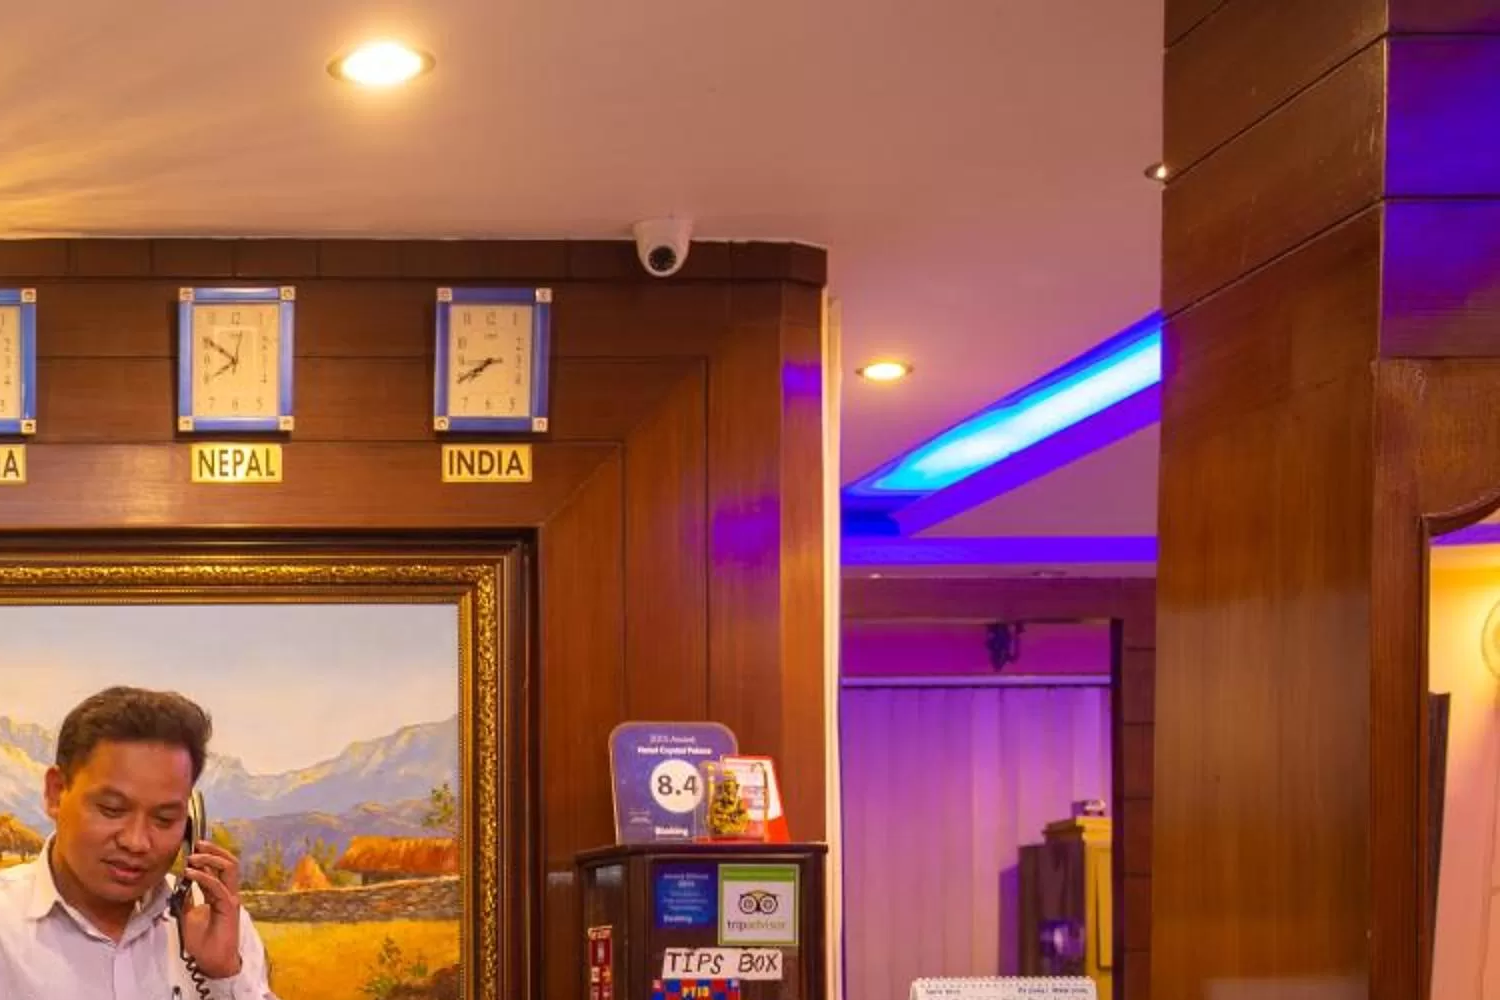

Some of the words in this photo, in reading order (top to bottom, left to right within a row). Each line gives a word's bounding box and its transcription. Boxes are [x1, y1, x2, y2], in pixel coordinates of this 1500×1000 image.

[198, 449, 276, 478] NEPAL
[447, 449, 524, 477] INDIA
[657, 775, 698, 796] 8.4
[667, 951, 725, 974] TIPS
[738, 952, 779, 972] BOX
